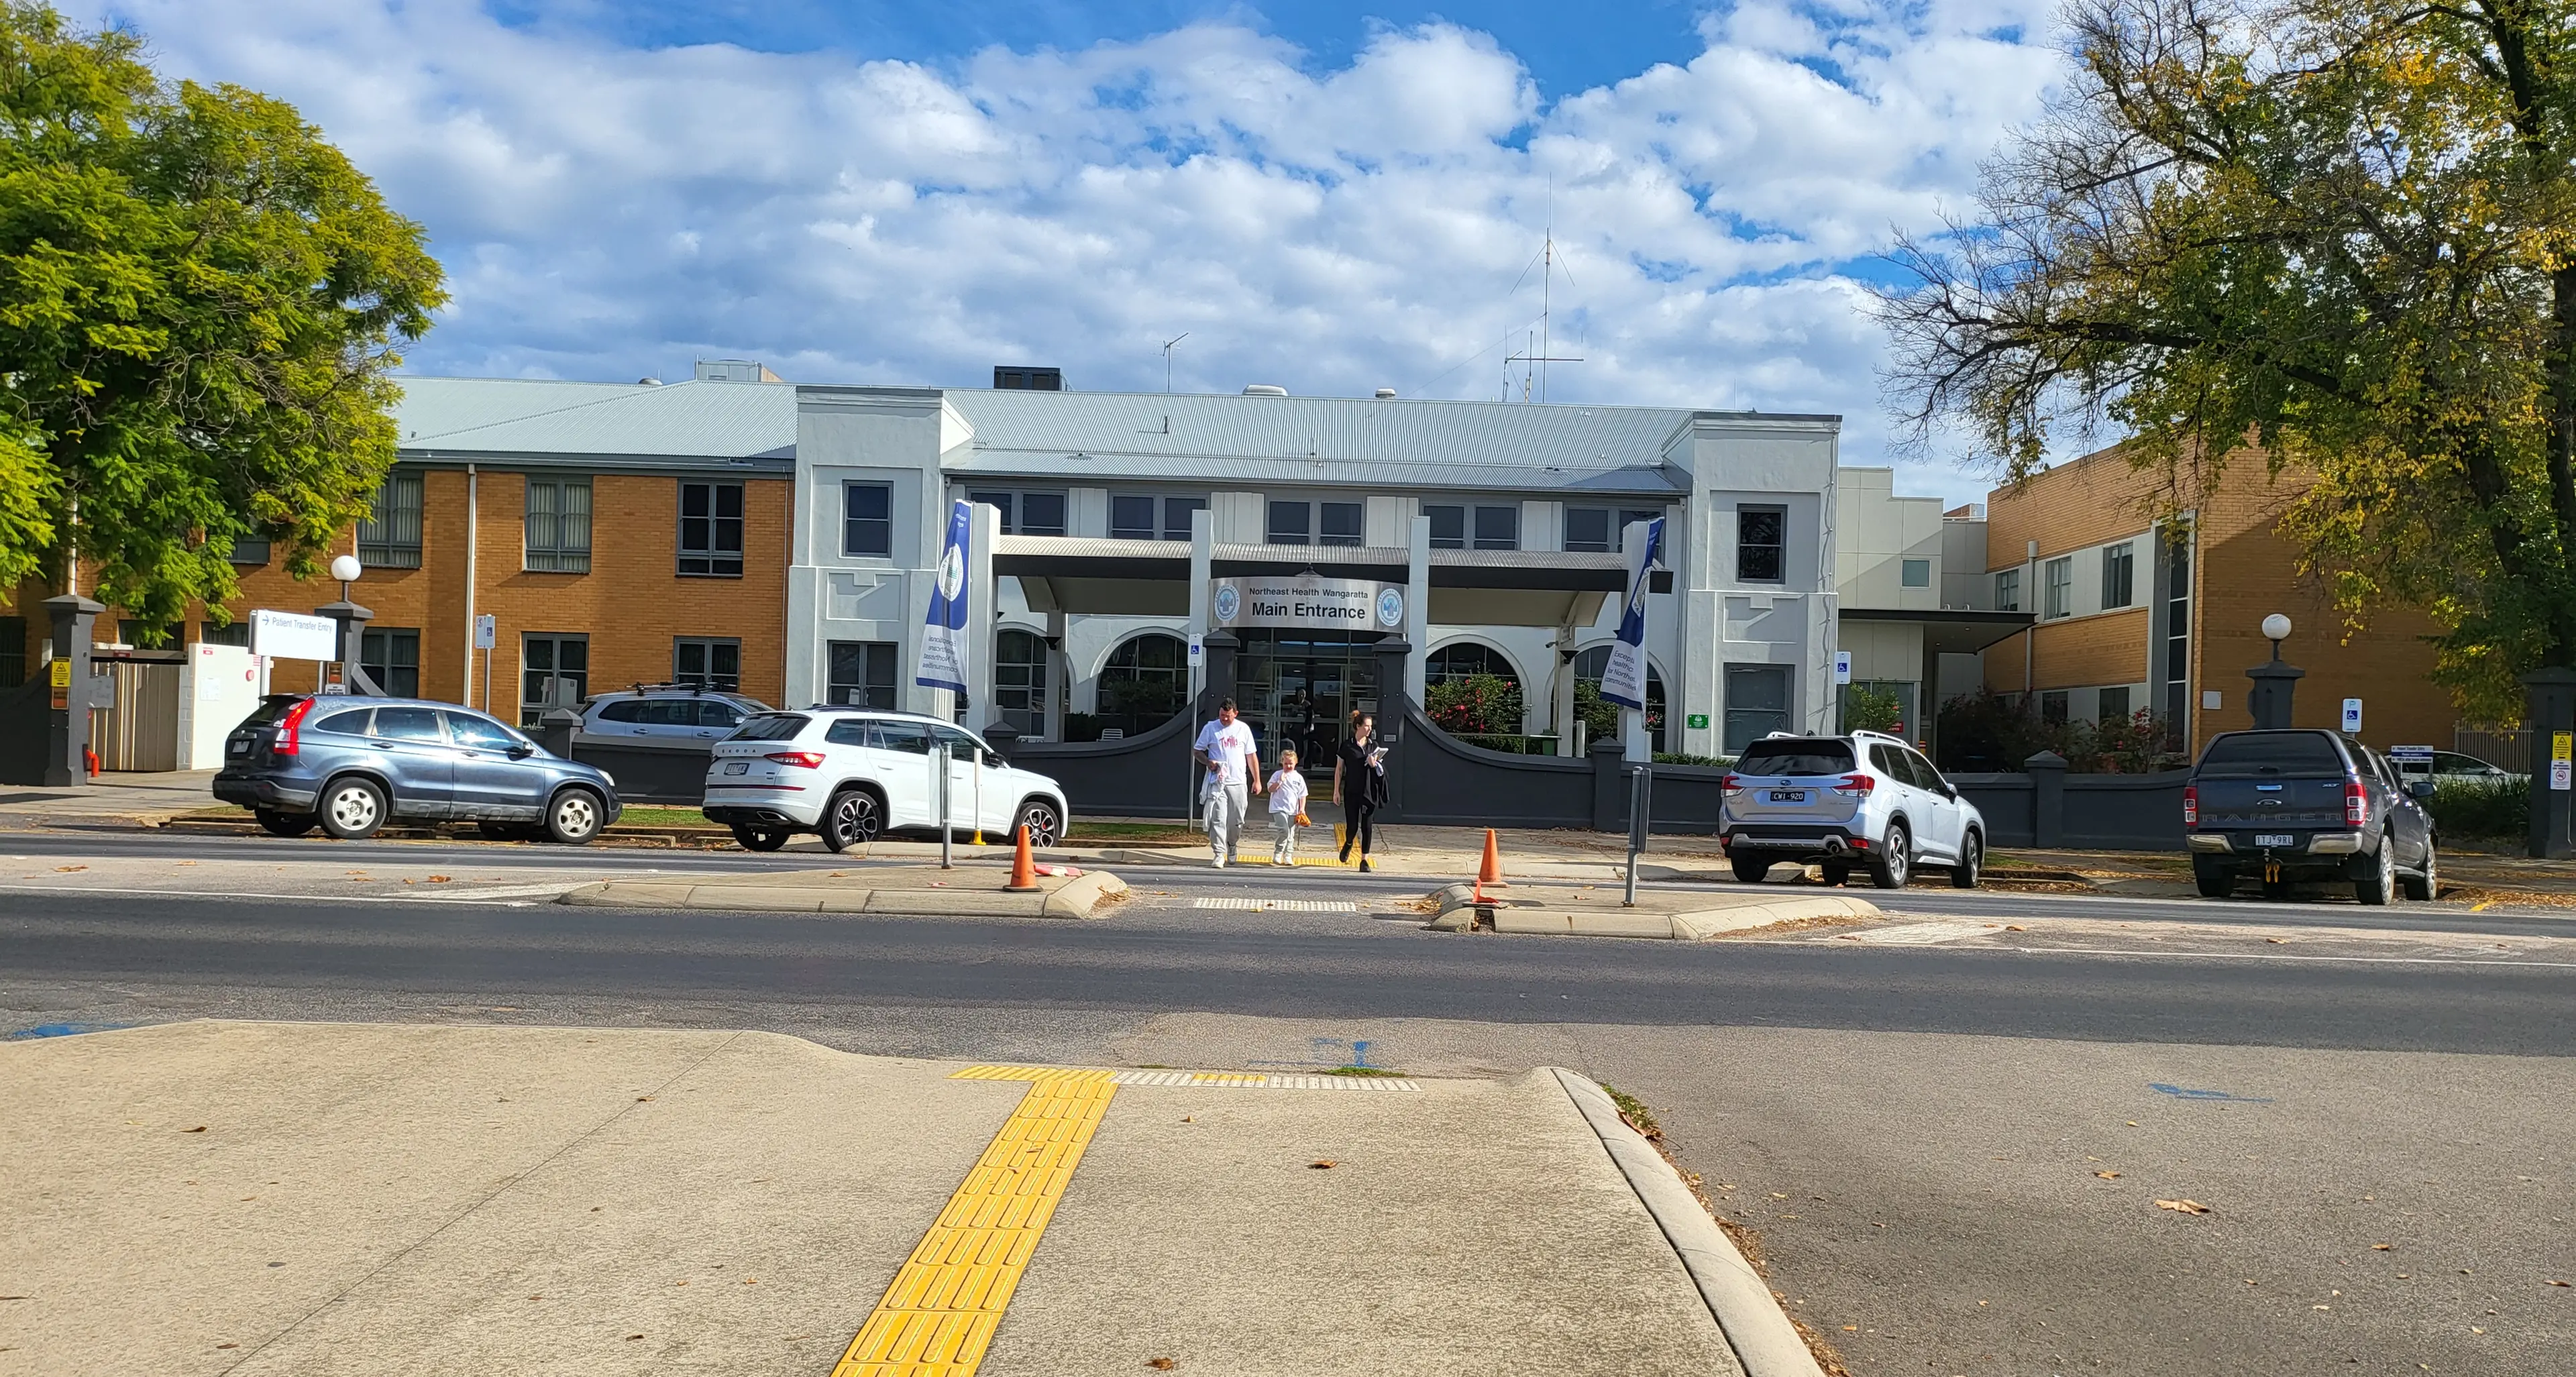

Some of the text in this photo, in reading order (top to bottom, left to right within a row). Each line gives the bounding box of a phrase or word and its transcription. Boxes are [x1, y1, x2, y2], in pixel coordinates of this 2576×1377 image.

[1249, 588, 1368, 599] Northeast Health Wangaratta
[1252, 602, 1288, 616] Main
[1295, 603, 1366, 619] Entrance
[272, 617, 332, 634] Patient Transfer Entry
[2202, 814, 2342, 822] RANGER
